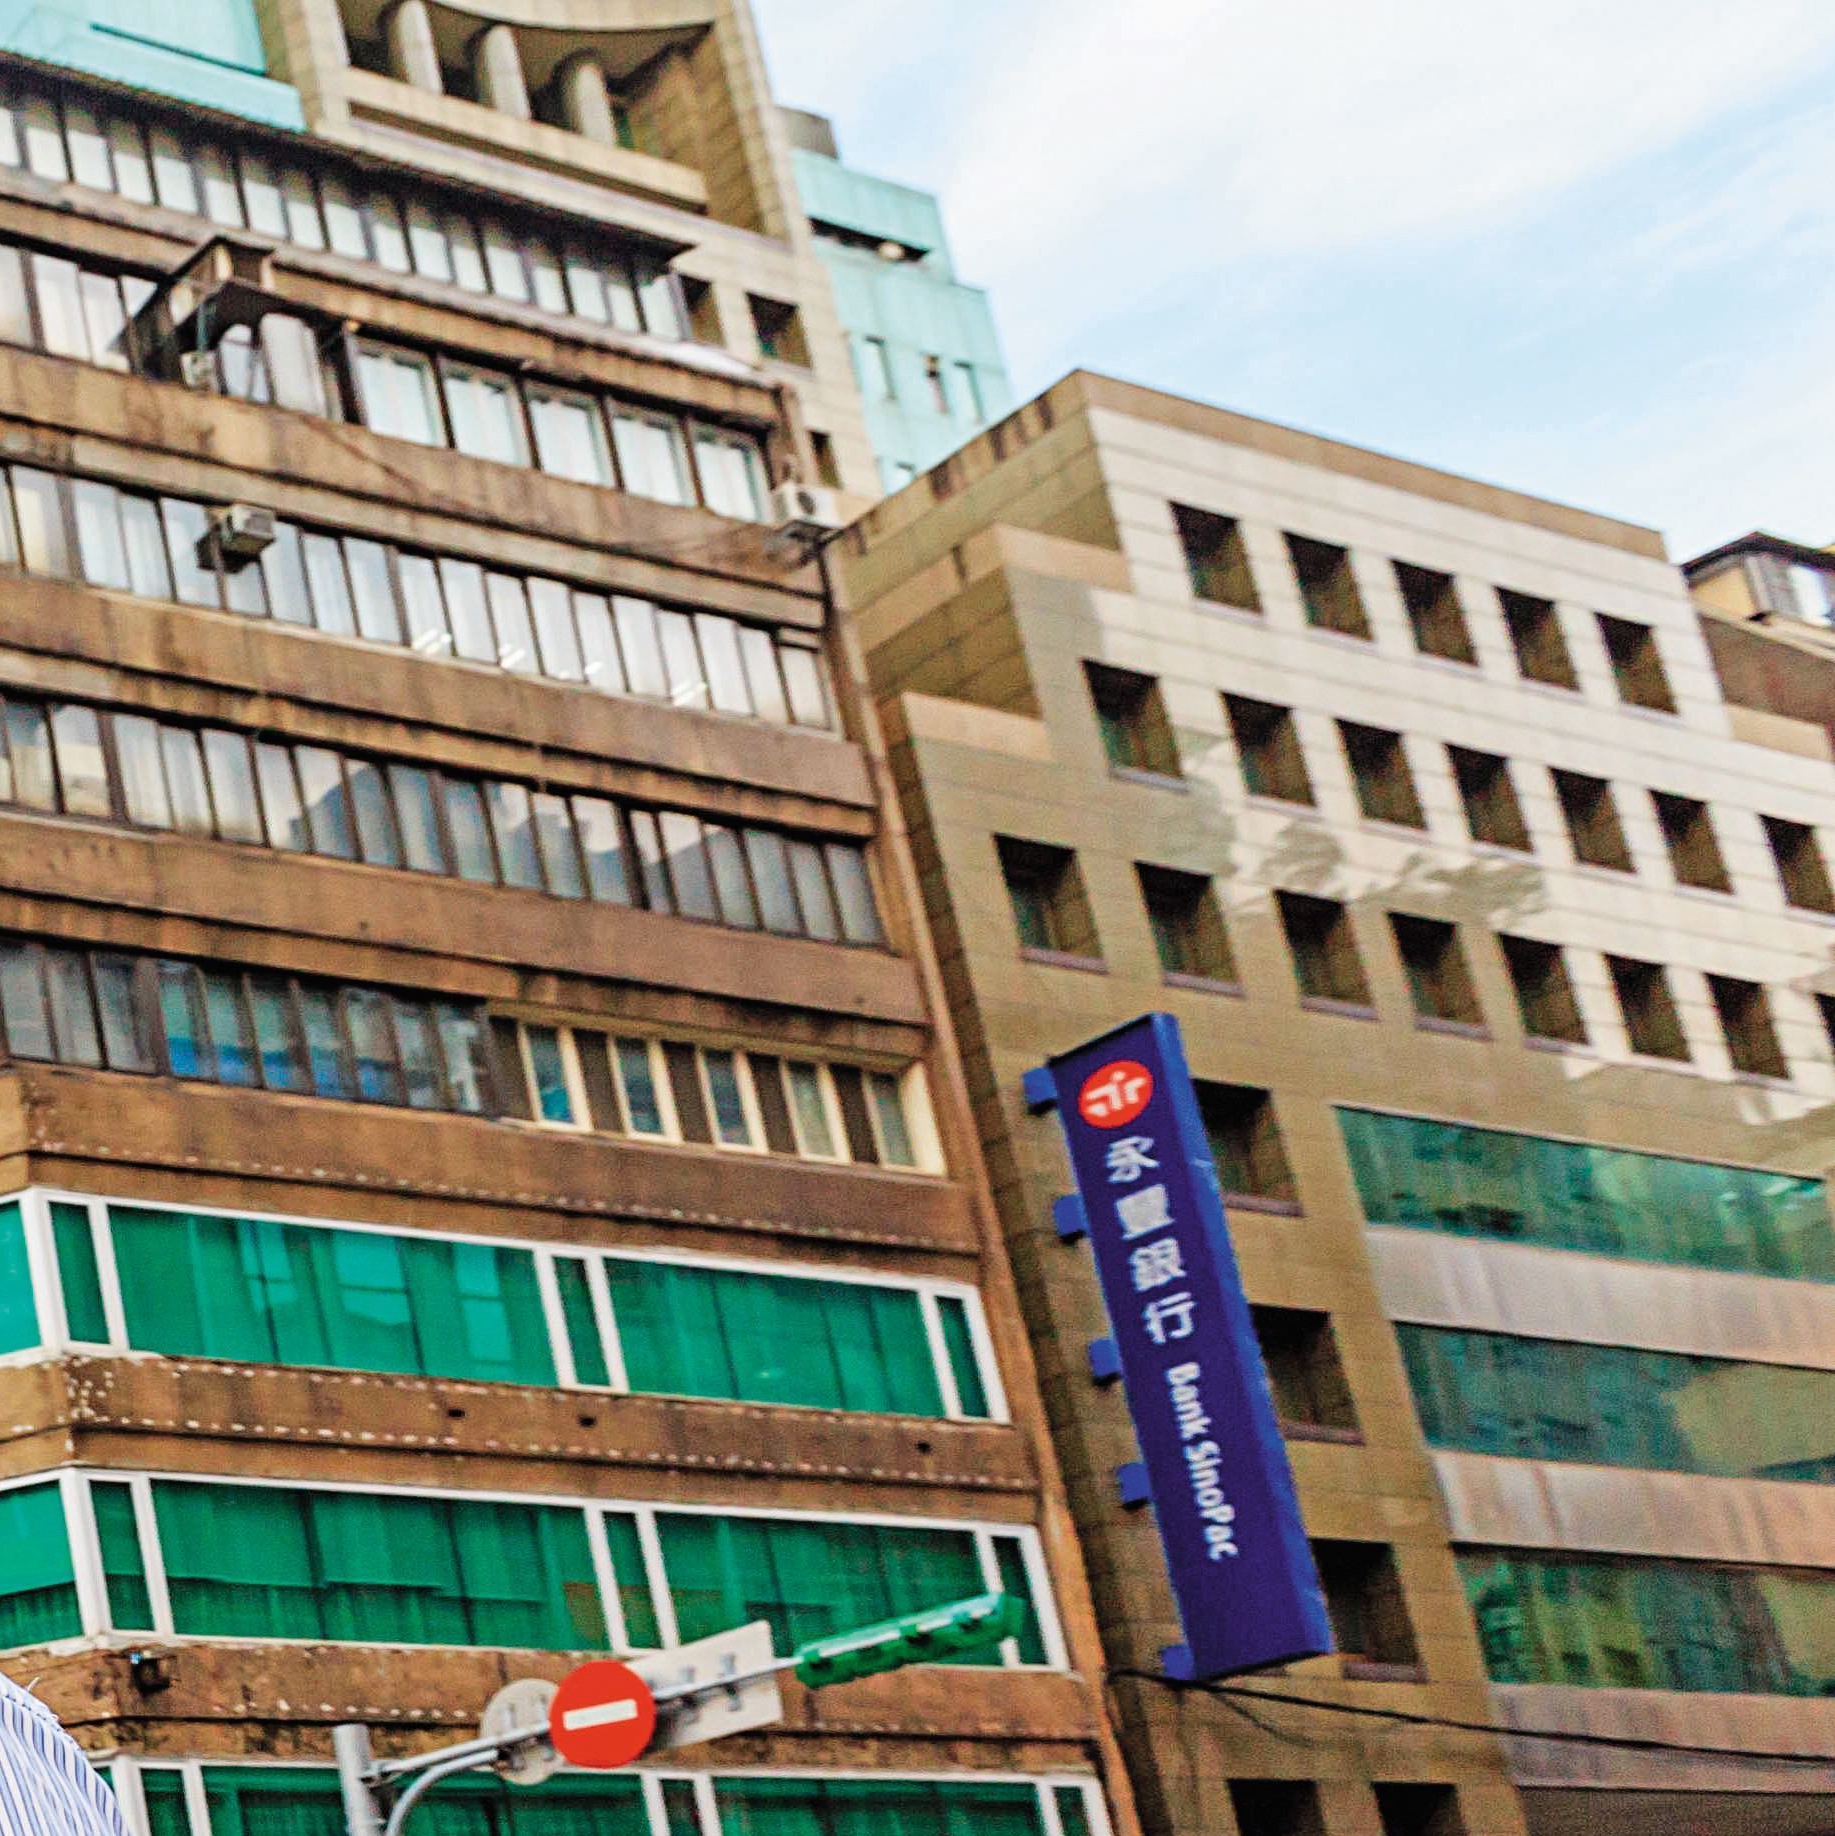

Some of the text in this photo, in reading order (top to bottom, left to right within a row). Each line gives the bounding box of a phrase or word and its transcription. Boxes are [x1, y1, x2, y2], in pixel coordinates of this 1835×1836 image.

[1105, 1136, 1197, 1344] 永豐銀行
[1165, 1362, 1240, 1562] Bank SinoPac
